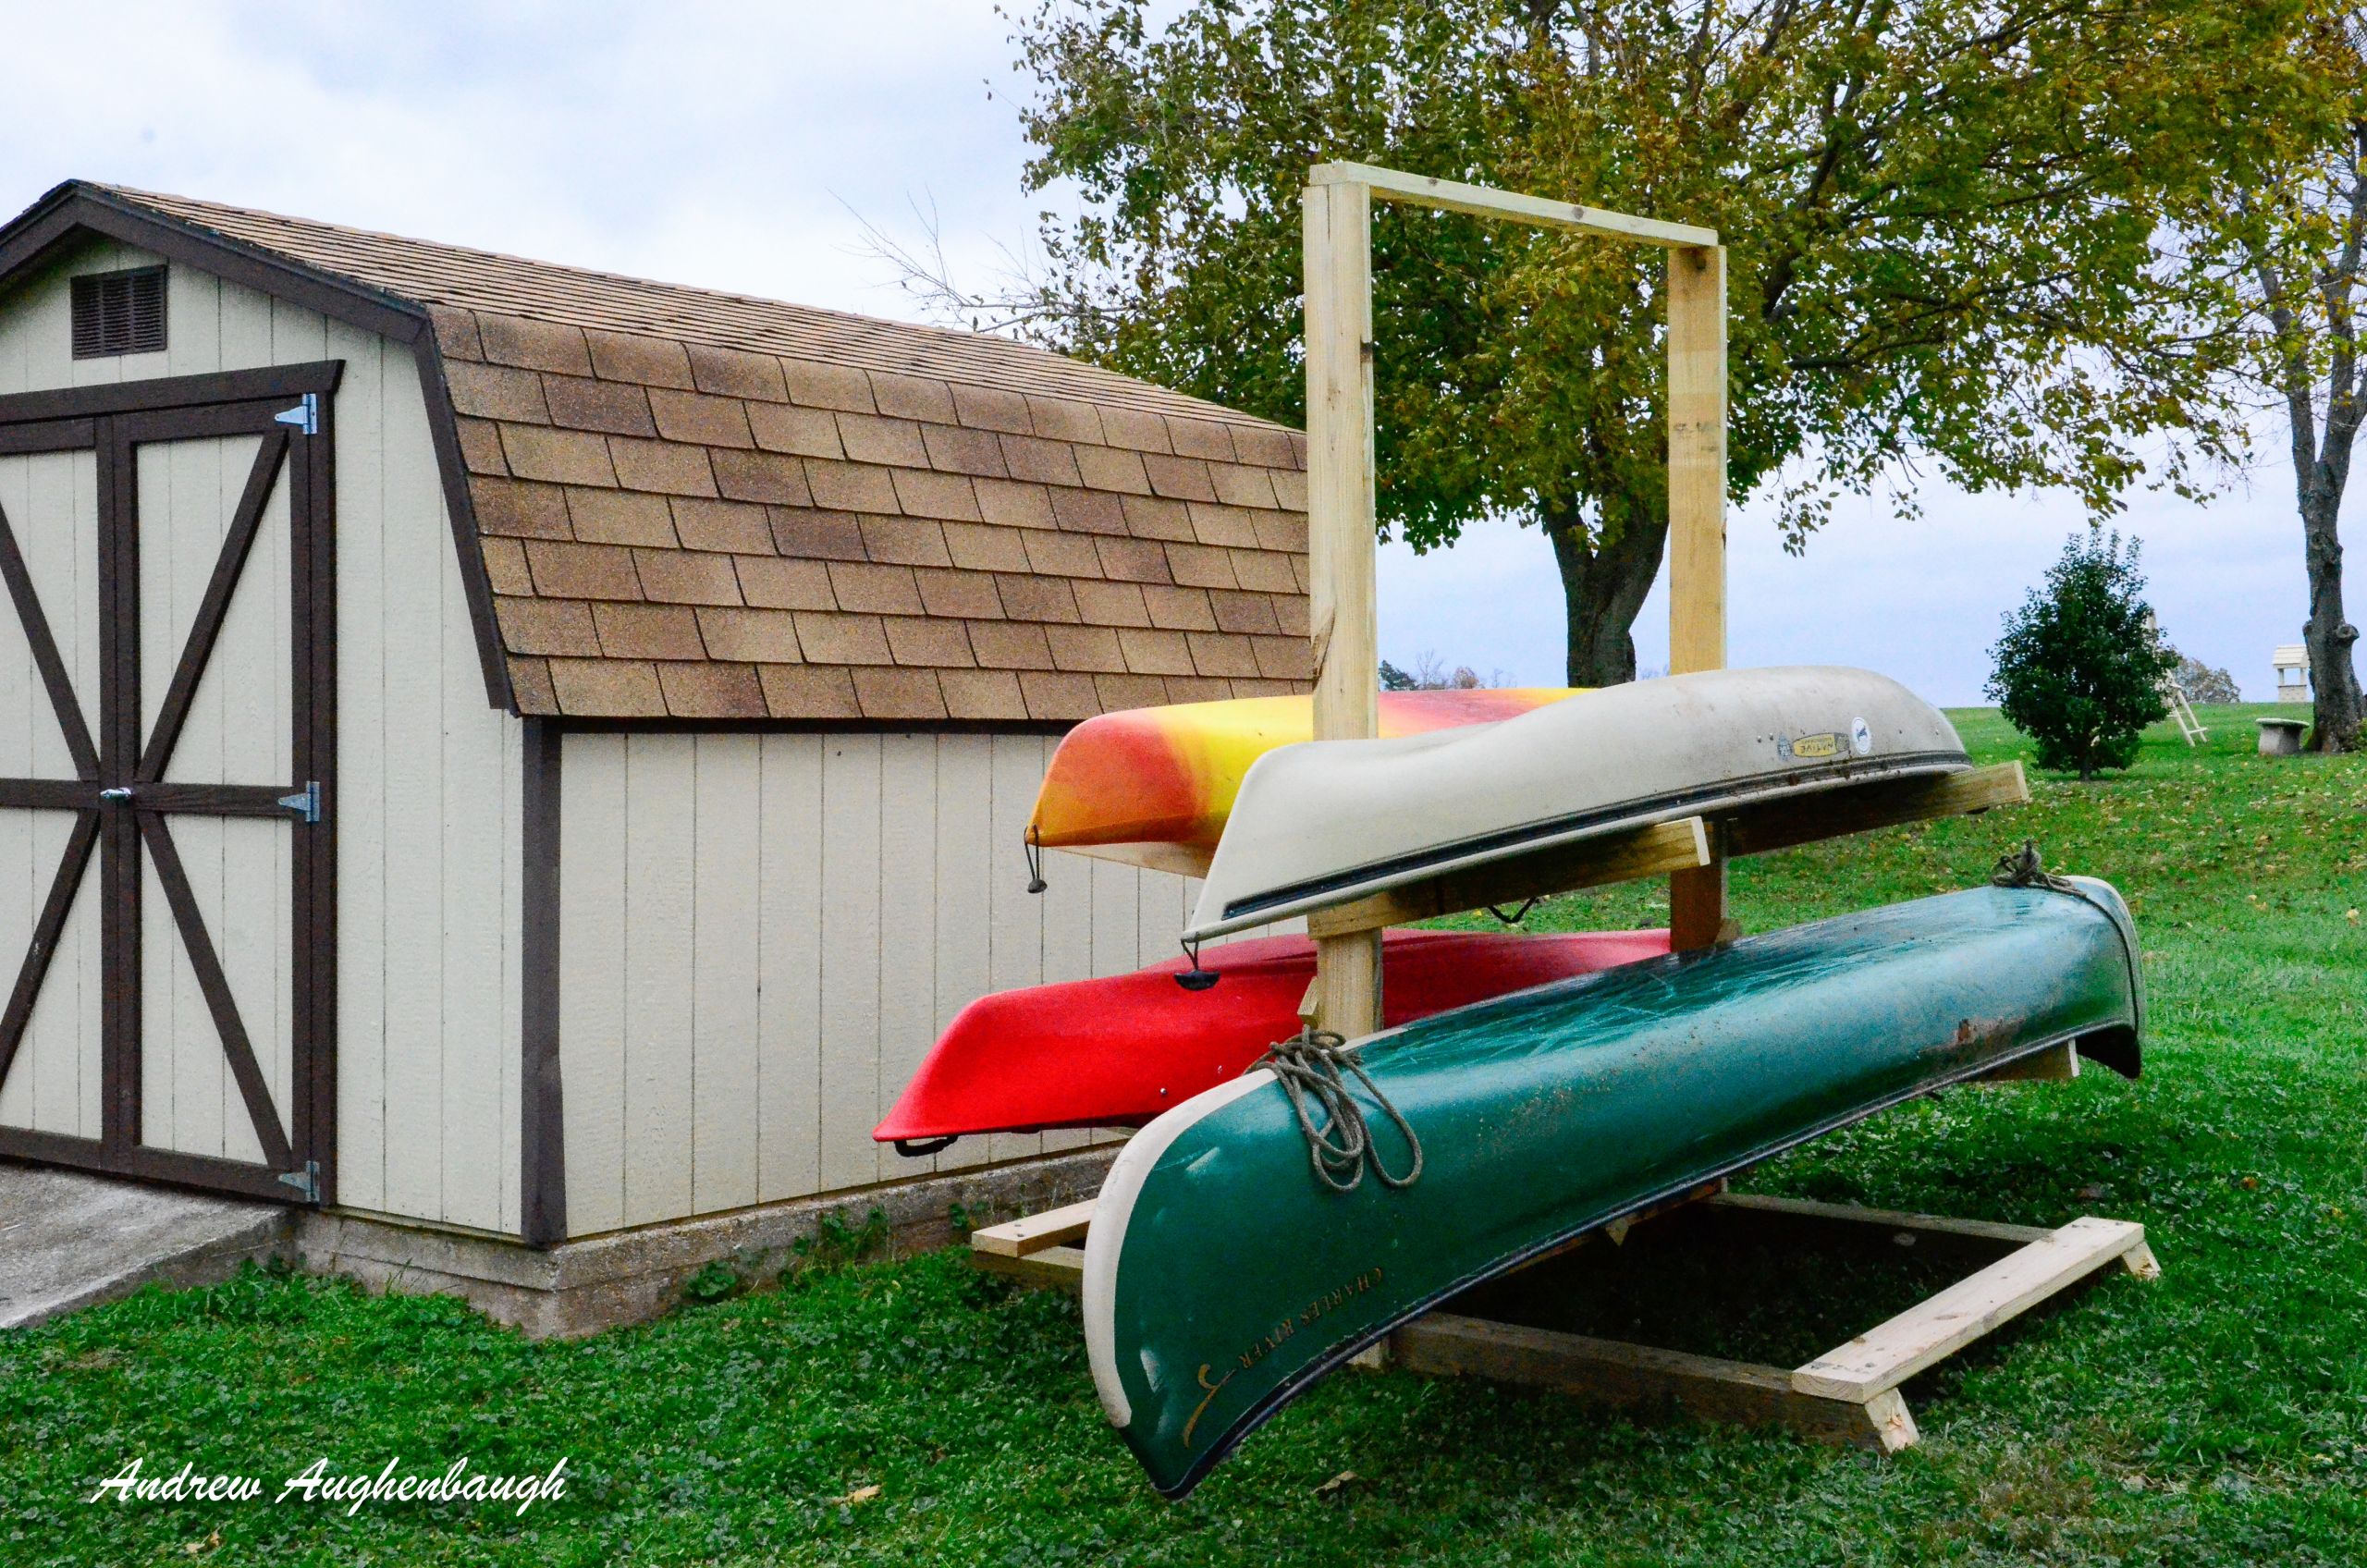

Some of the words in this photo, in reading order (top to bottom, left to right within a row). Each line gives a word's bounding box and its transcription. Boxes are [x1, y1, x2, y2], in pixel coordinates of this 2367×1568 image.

[1799, 742, 1834, 754] NATIVE
[1300, 1268, 1382, 1326] CHARLES
[1239, 1317, 1295, 1369] RIVER
